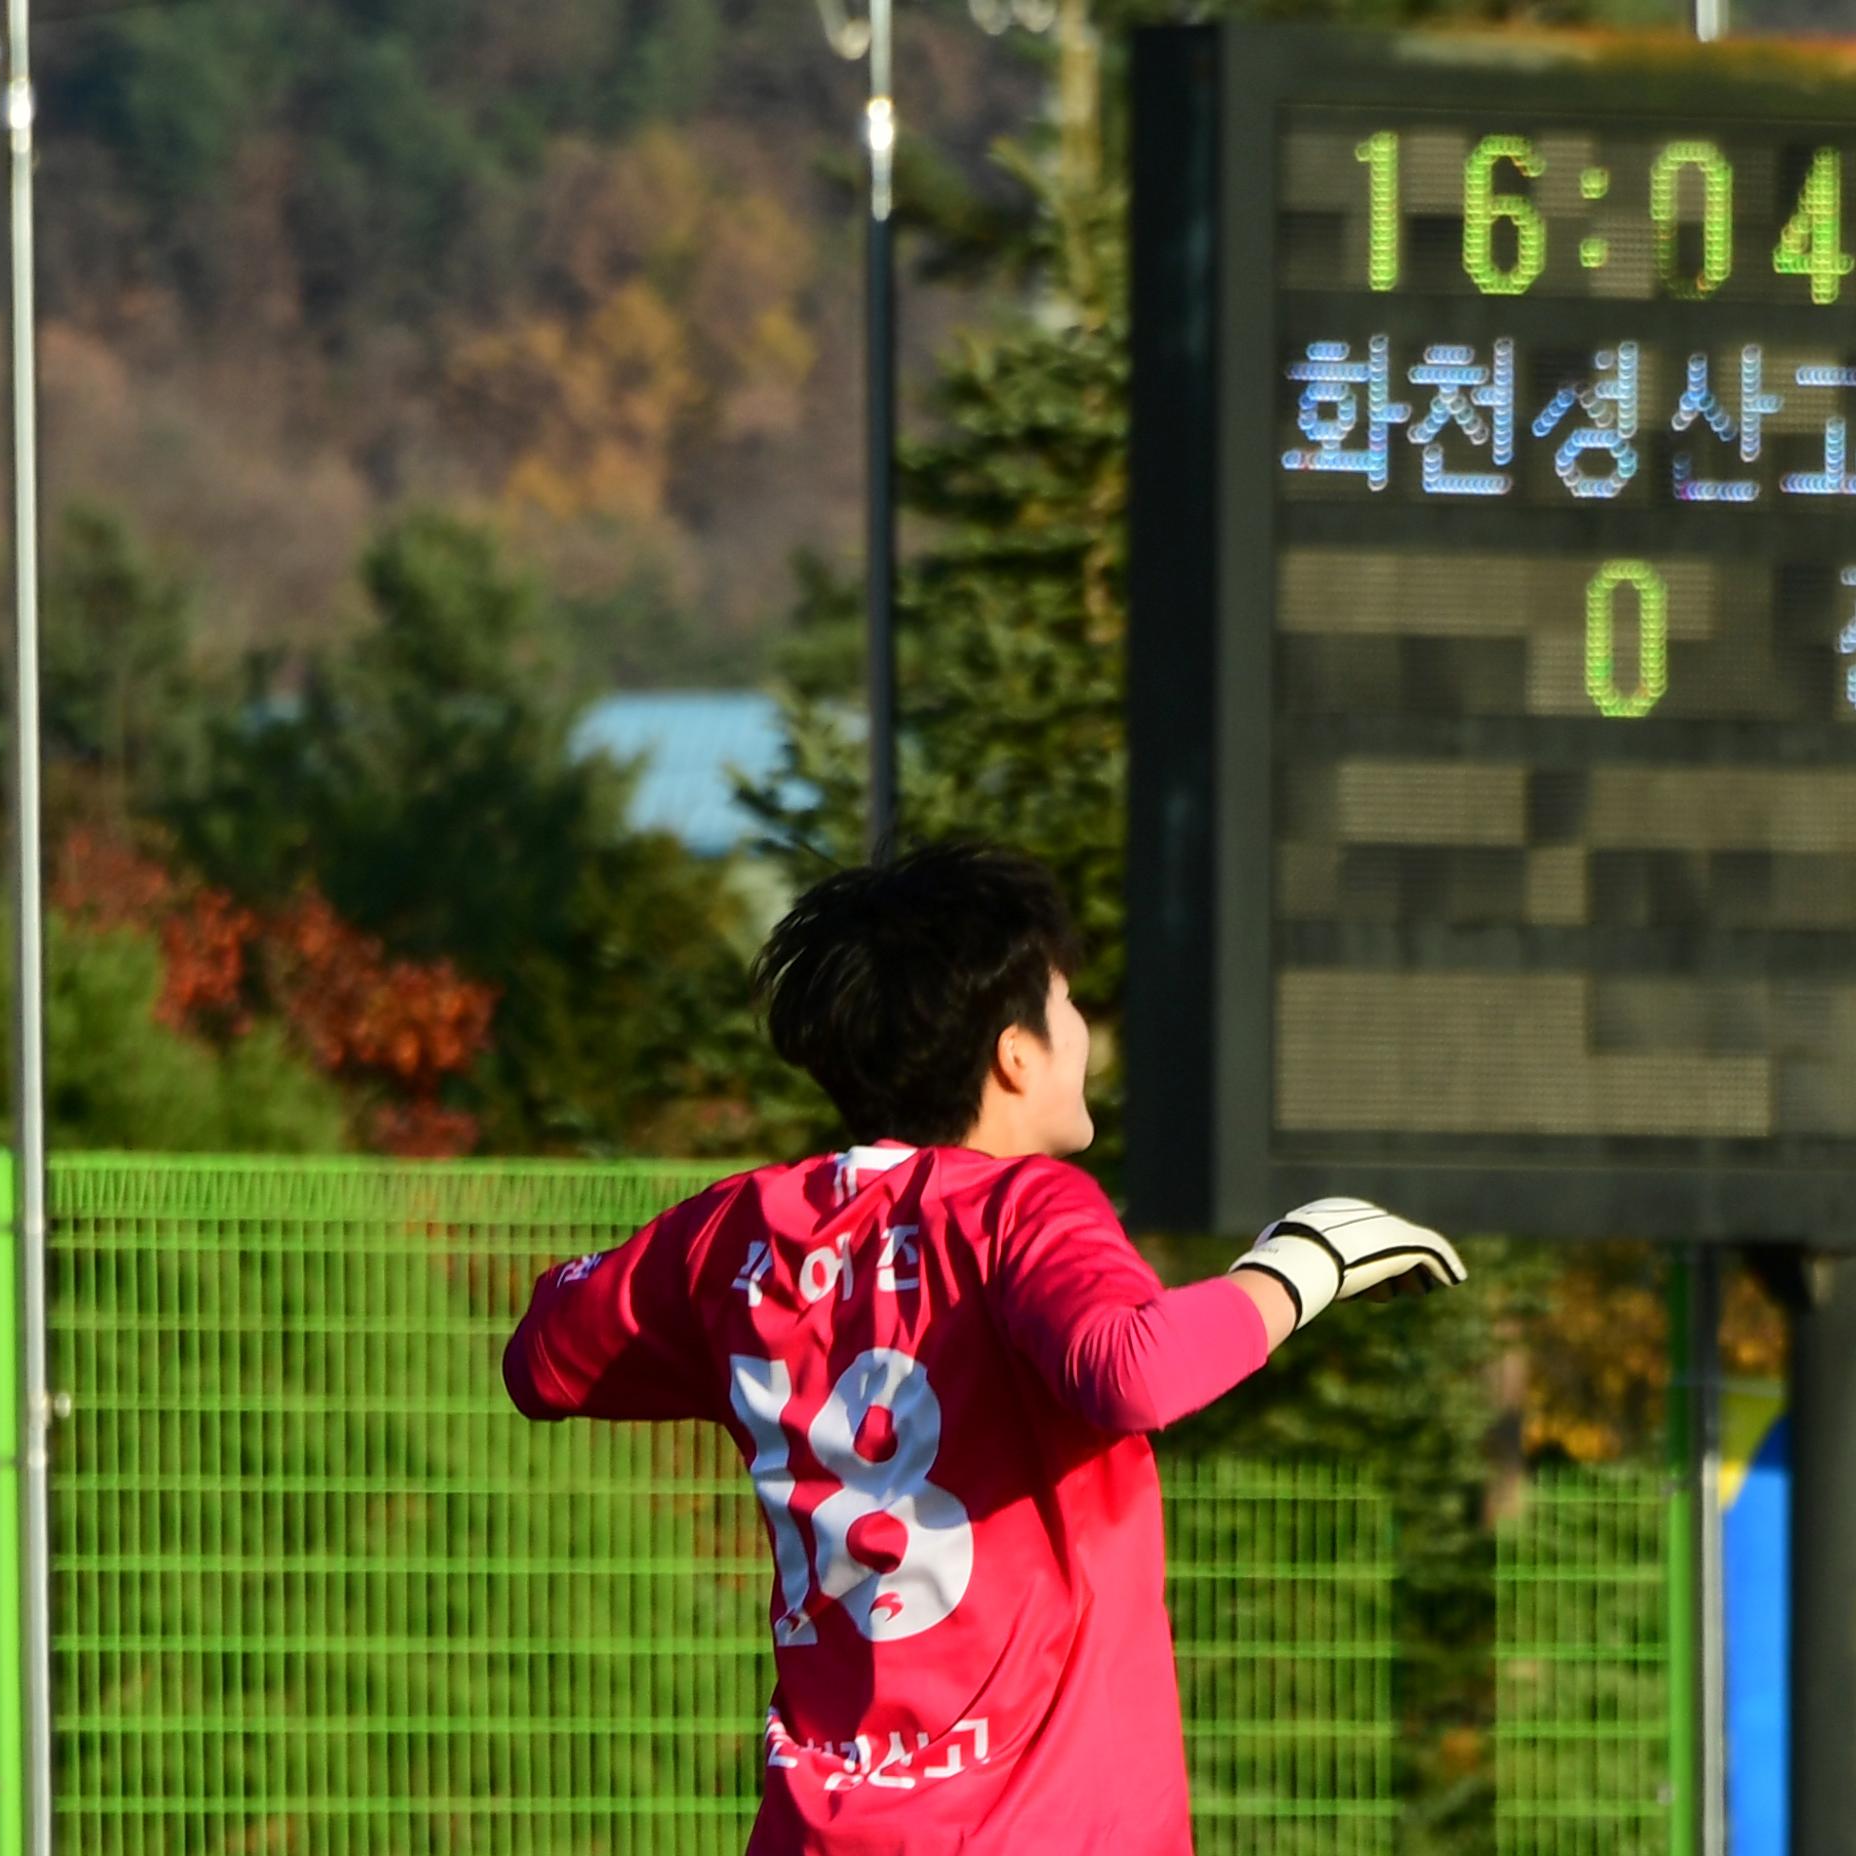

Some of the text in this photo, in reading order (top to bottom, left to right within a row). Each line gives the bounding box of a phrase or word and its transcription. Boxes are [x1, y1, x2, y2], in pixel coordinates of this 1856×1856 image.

[1353, 130, 1855, 305] 16:04
[1584, 558, 1667, 718] 0
[730, 1347, 974, 1647] 18
